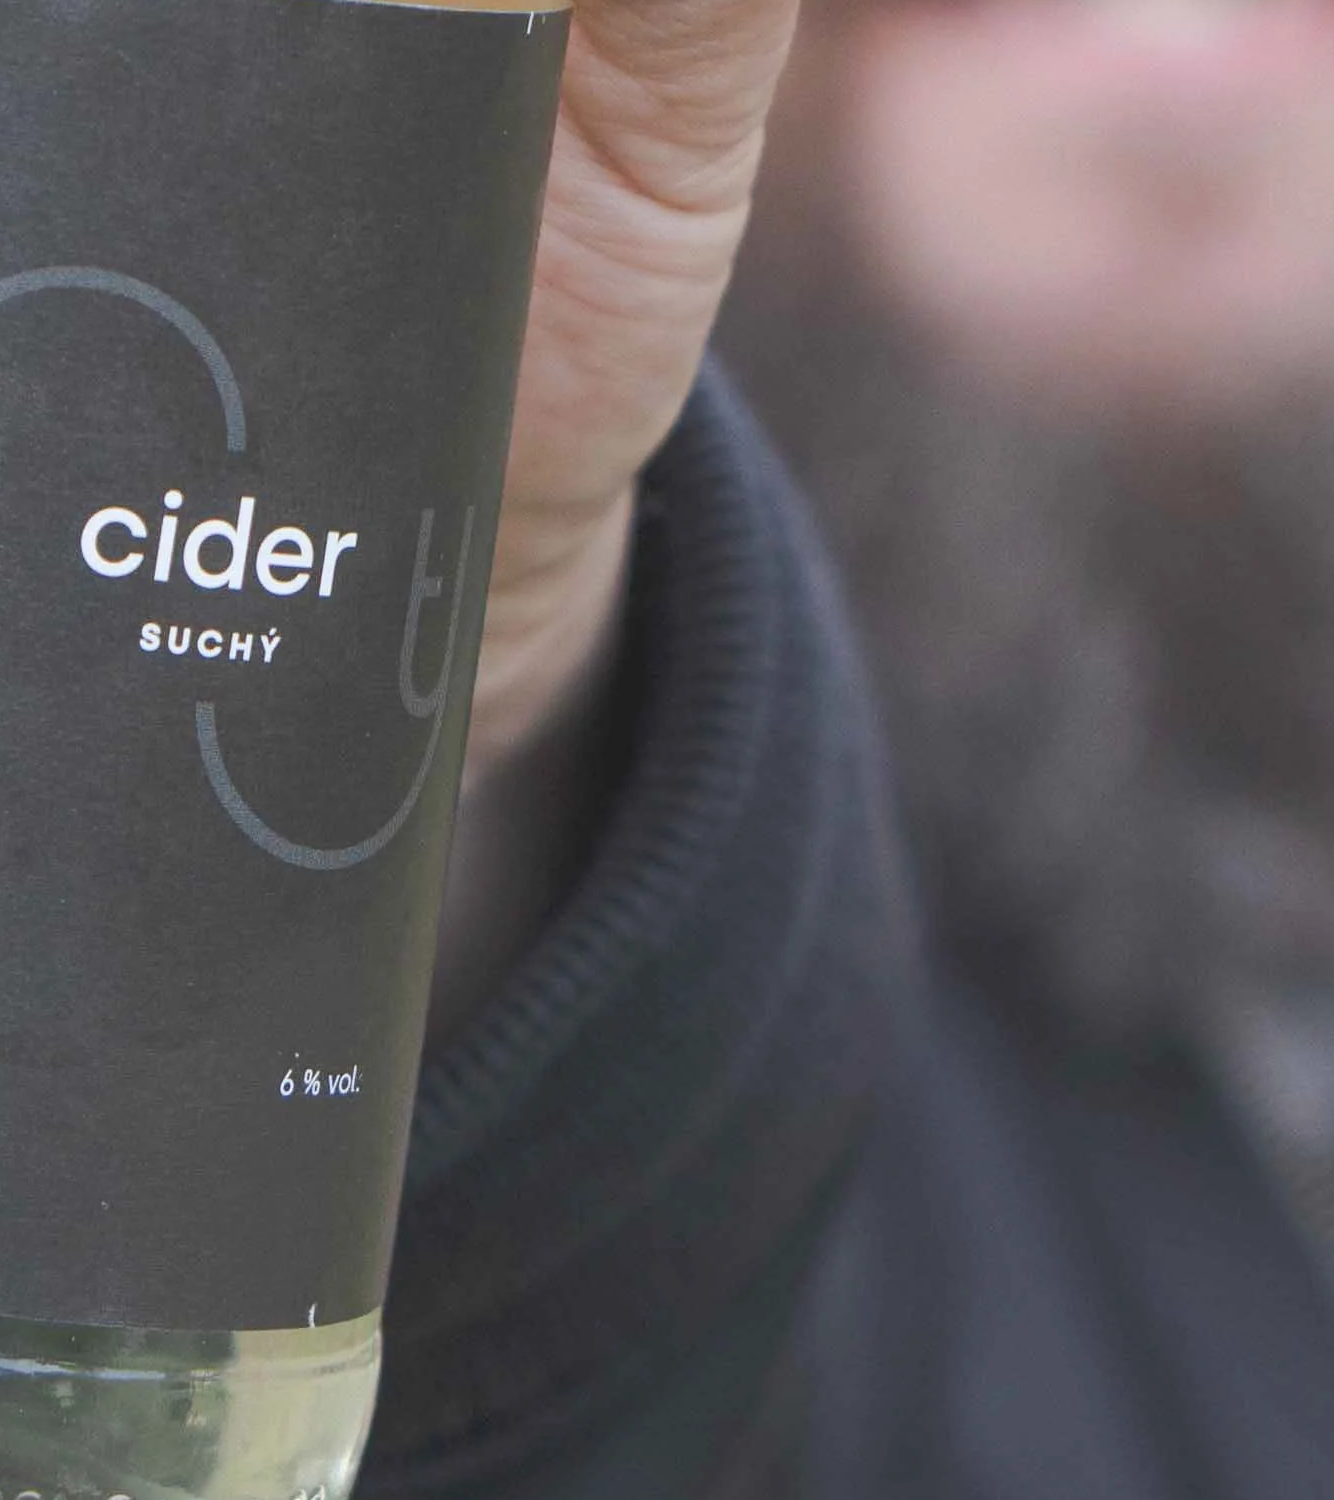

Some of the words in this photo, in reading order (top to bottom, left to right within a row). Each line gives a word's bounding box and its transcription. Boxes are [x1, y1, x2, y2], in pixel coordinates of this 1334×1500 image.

[79, 489, 358, 598] cider
[139, 622, 281, 663] SUCHÝ
[279, 1068, 295, 1096] 6
[303, 1068, 321, 1096] %
[328, 1064, 360, 1096] vol.
